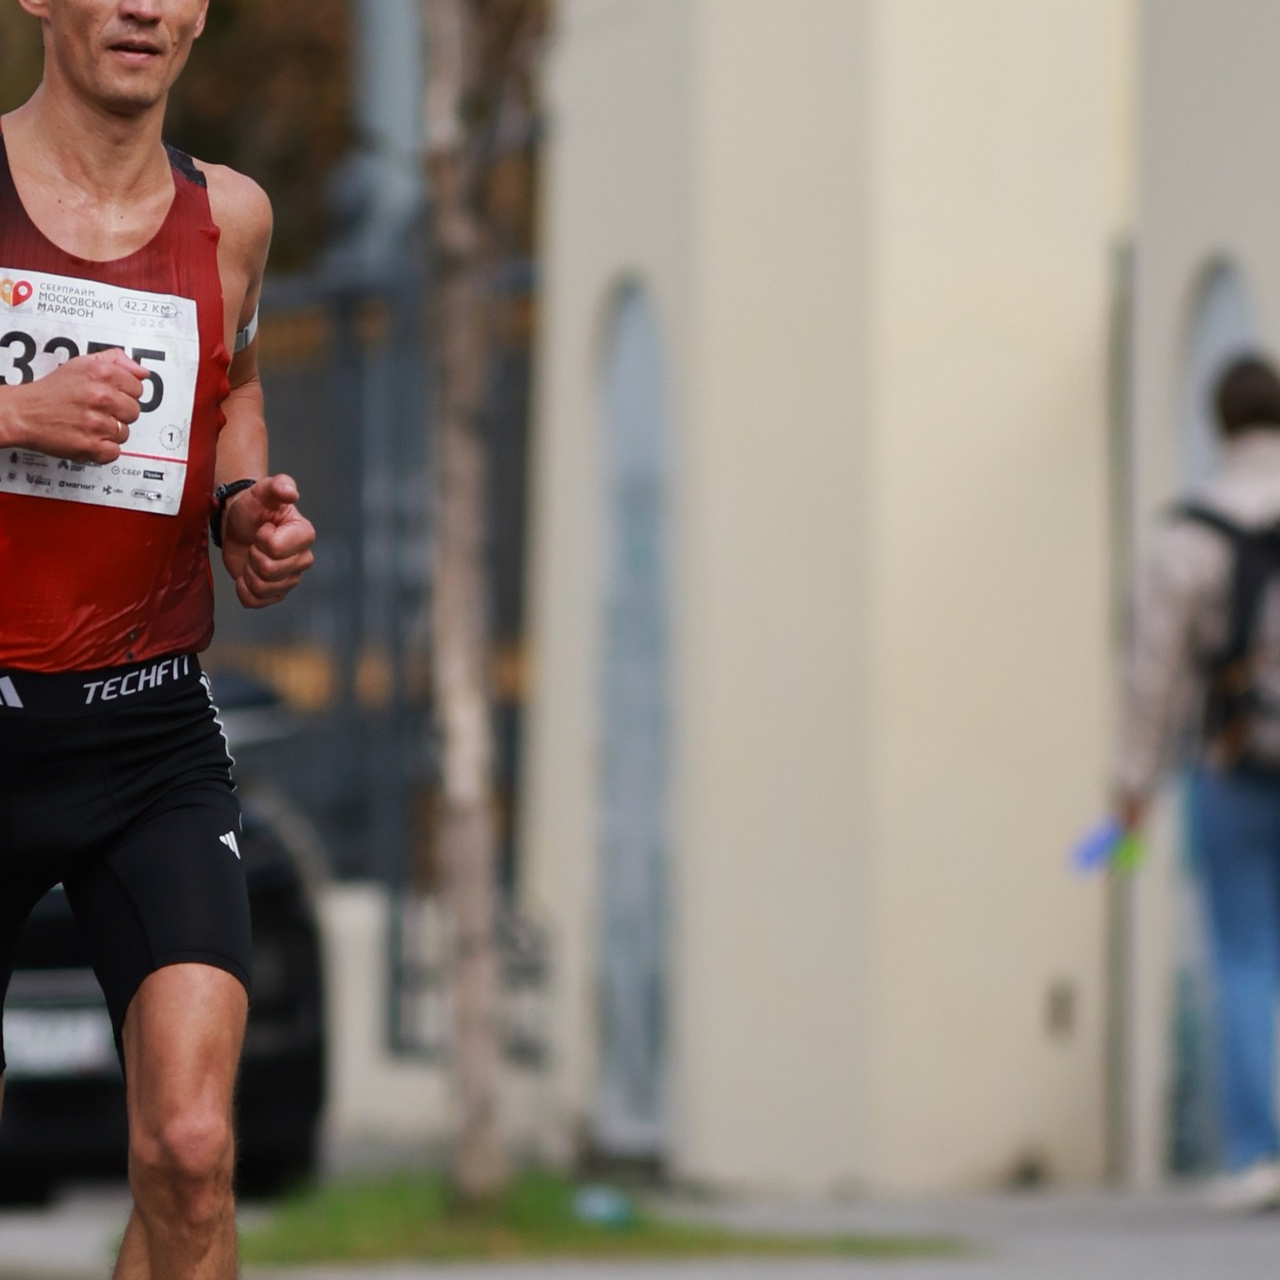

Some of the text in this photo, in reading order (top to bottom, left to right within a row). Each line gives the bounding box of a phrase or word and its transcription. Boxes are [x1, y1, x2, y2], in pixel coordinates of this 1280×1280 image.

[39, 282, 95, 297] СБЕРПРАЙМ
[37, 302, 94, 319] МАРАФОН
[38, 292, 114, 311] МОСКОВСКИЙ
[83, 655, 189, 705] TECHFIT
